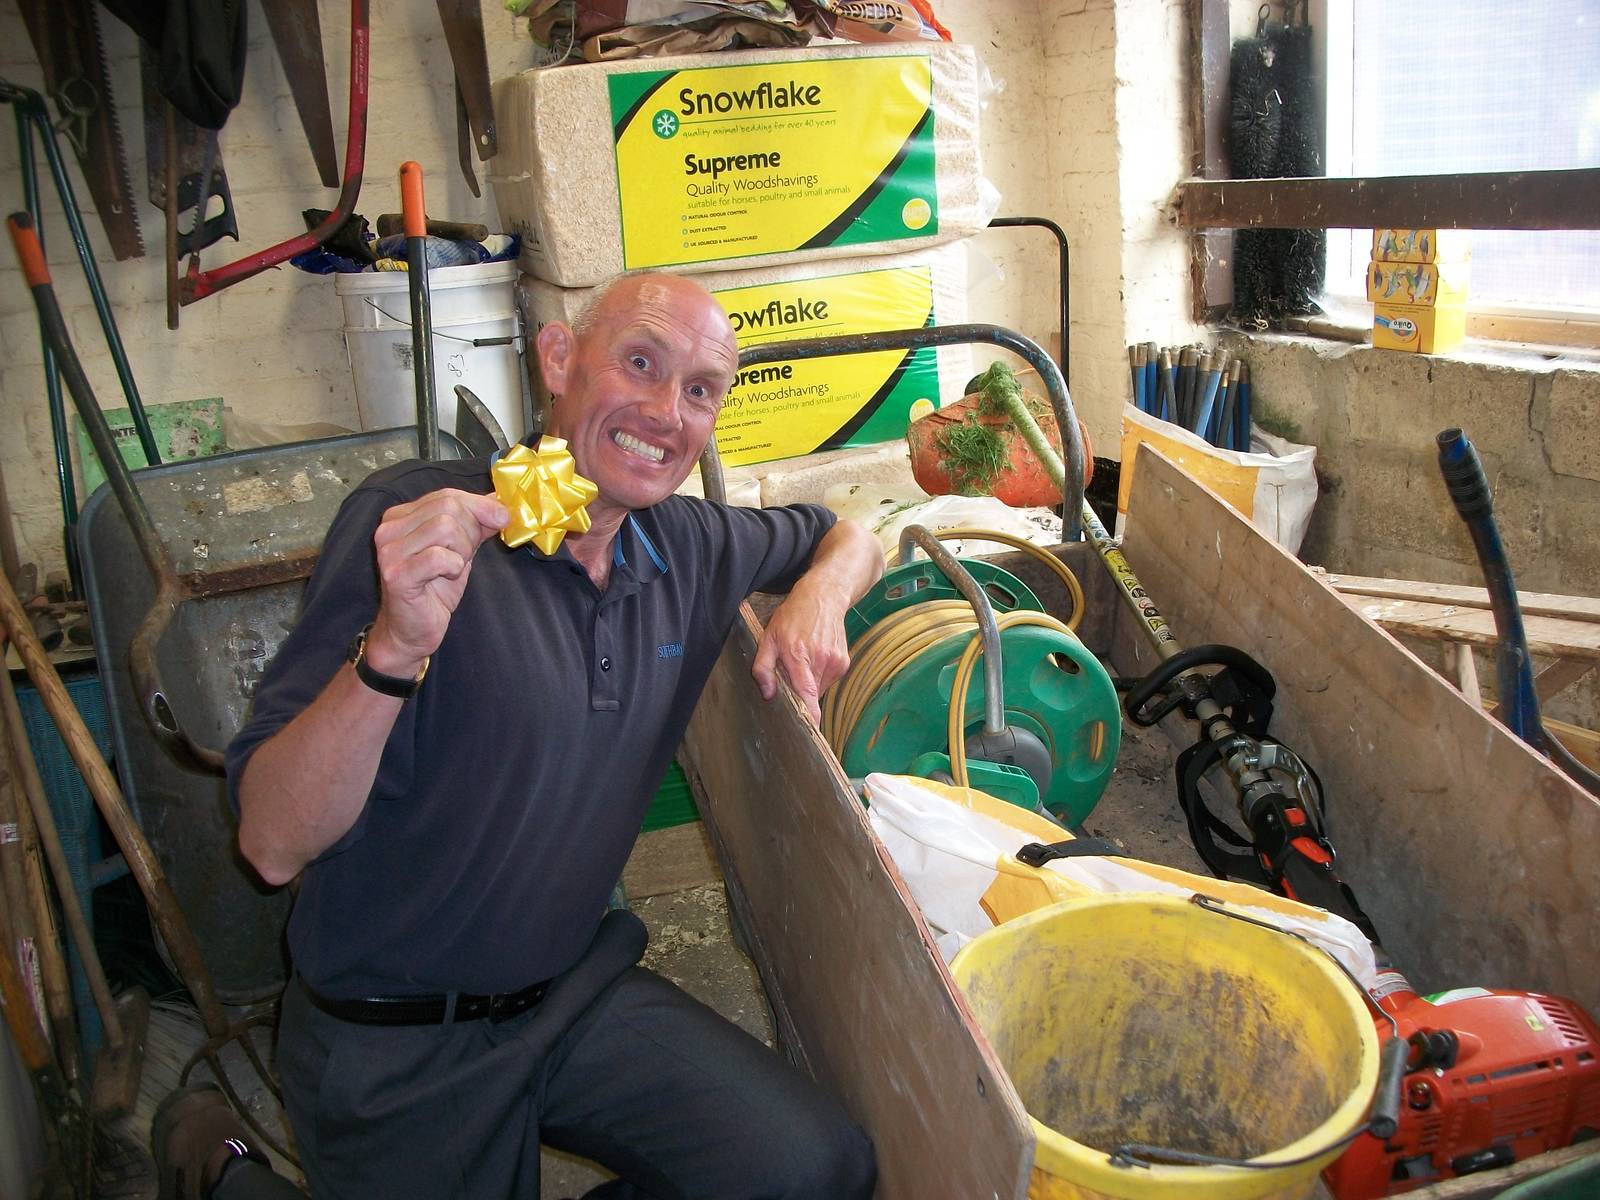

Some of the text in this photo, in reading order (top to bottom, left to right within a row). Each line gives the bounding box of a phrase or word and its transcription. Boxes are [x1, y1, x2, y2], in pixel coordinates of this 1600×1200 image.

[679, 80, 822, 116] Snowflake
[682, 118, 837, 139] quality animal bedding for over 40 years
[684, 151, 782, 180] Supreme
[686, 173, 819, 198] Quality Woodshavings
[687, 196, 718, 209] suitable
[719, 195, 731, 206] for
[759, 191, 787, 203] poultry
[788, 189, 803, 199] and
[804, 187, 823, 198] small
[824, 185, 852, 195] animals
[701, 225, 727, 233] EXTRACTED
[722, 235, 759, 243] MANUFACTURED
[728, 297, 829, 332] owflake
[728, 364, 793, 395] preme
[722, 382, 830, 410] ality Woodshavings
[734, 410, 744, 418] for
[773, 401, 800, 414] poultry
[801, 398, 815, 408] and
[816, 396, 834, 406] small
[835, 392, 861, 402] animals
[724, 423, 741, 431] ODOUR
[737, 442, 773, 452] MANUFACTURED
